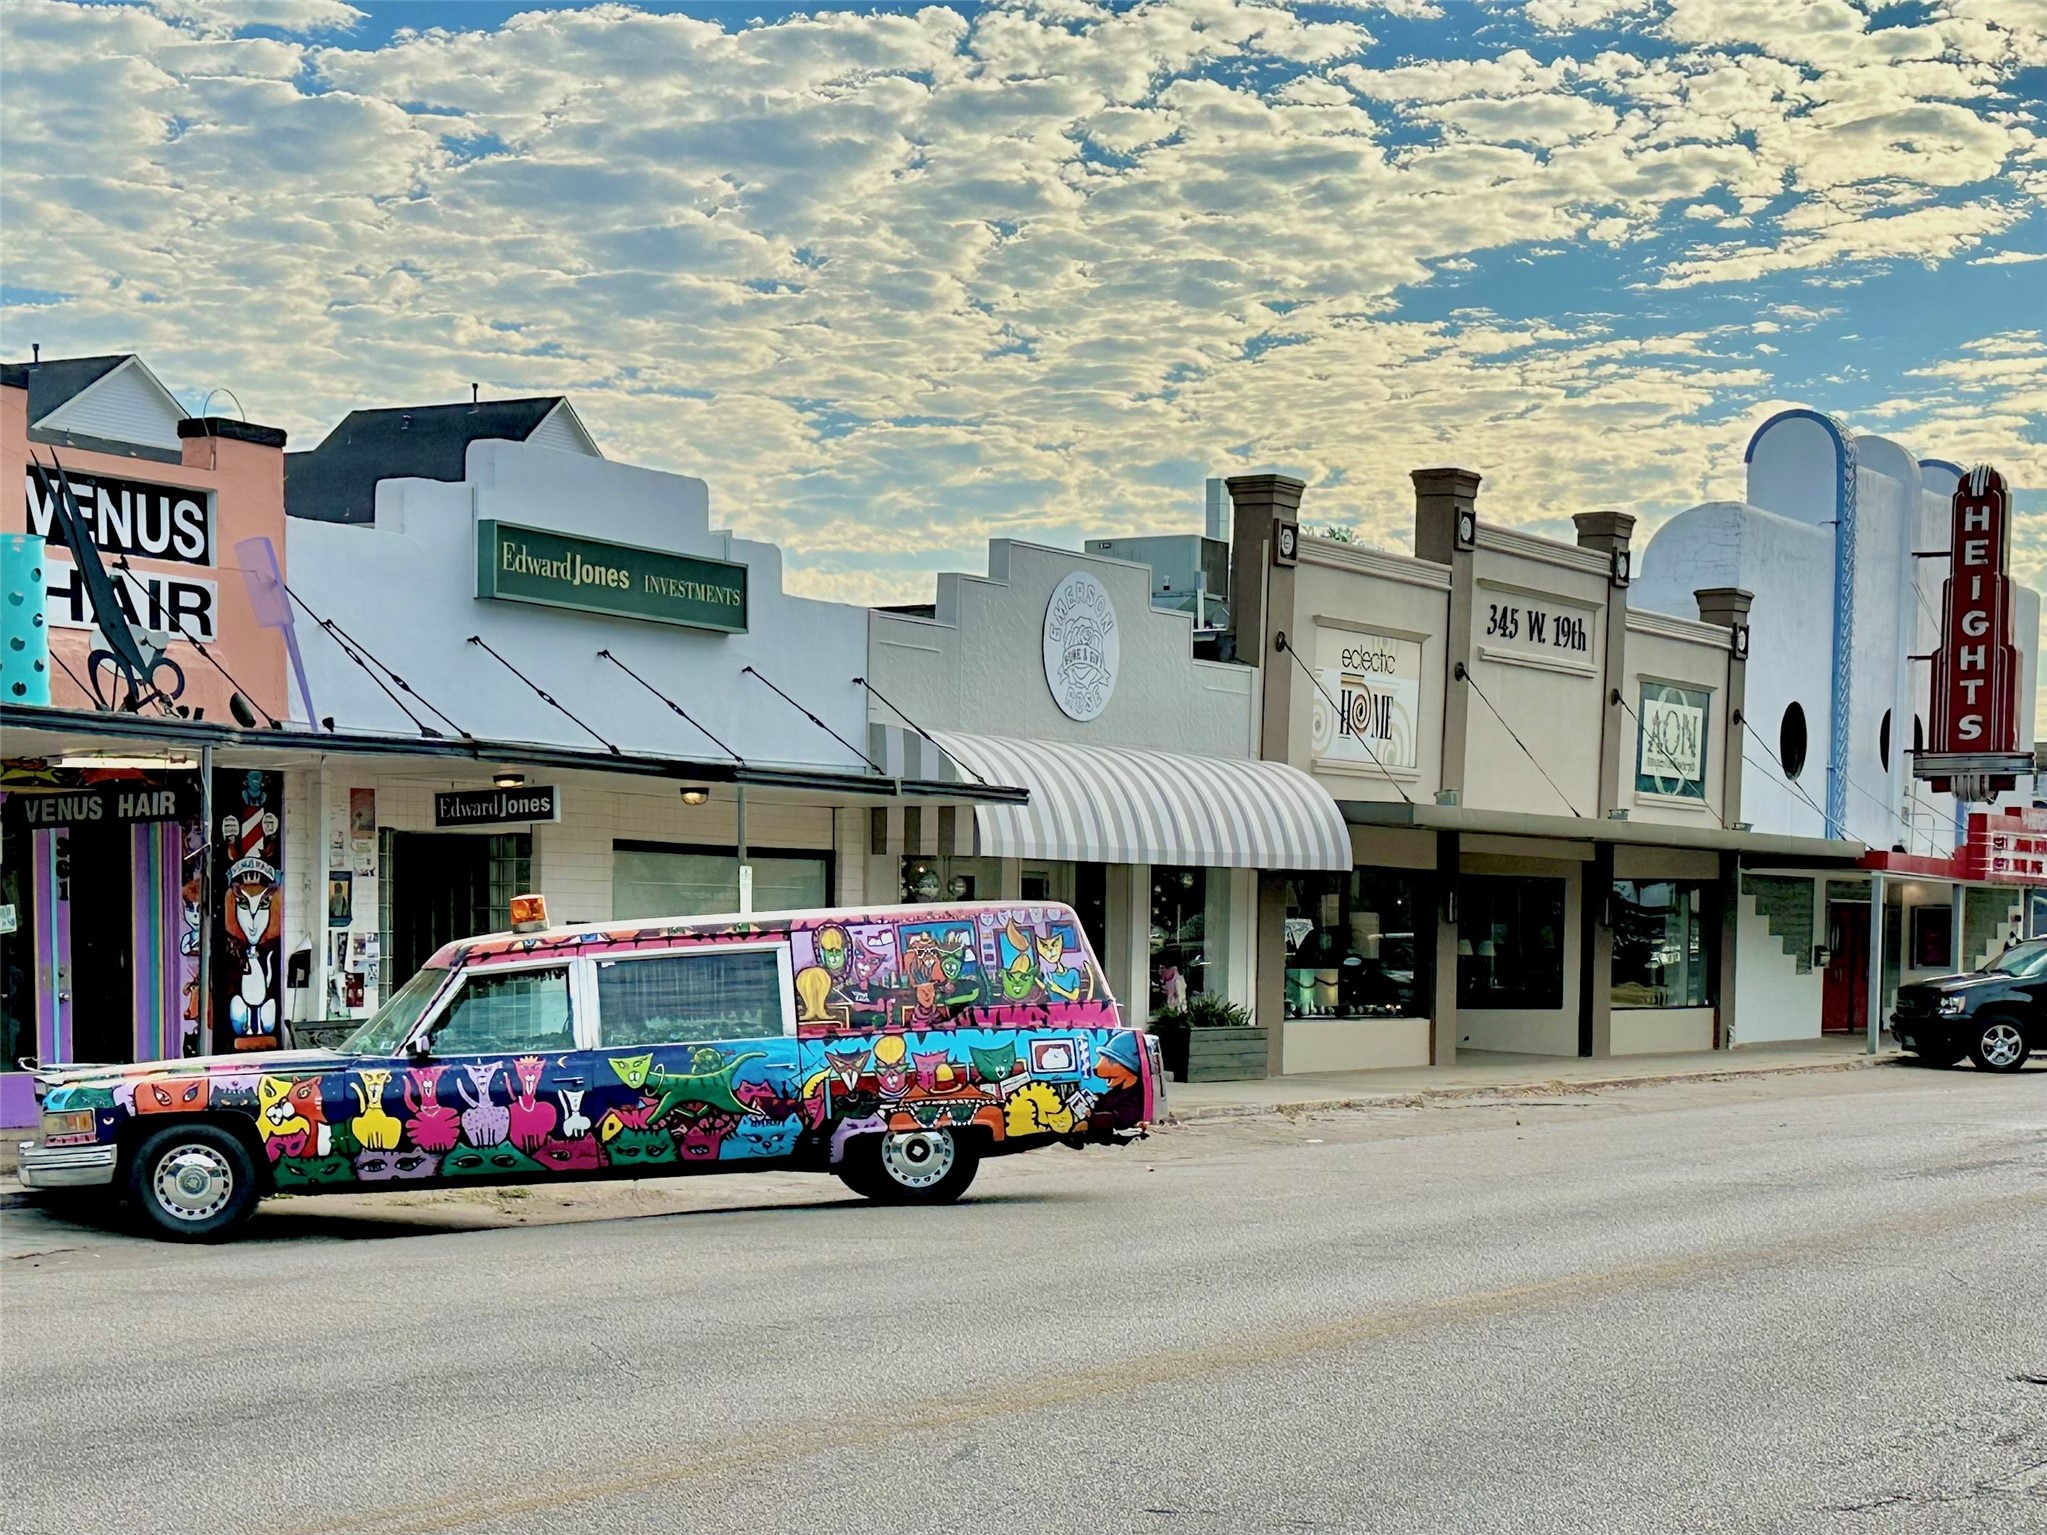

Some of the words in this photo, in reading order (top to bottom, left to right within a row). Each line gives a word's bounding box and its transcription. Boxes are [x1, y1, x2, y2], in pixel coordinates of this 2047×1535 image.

[26, 475, 206, 558] VENUS
[47, 568, 213, 637] HAIR
[644, 574, 741, 606] INVESTMENTS
[1050, 581, 1114, 642] EMERSON
[1486, 604, 1520, 639] 345
[1527, 610, 1546, 644] W.
[1553, 615, 1587, 651] 19th
[1957, 505, 1990, 741] HEIGHTS
[1341, 644, 1396, 674] eclectic
[1065, 684, 1103, 714] ROSE
[1339, 688, 1395, 740] HOME
[25, 795, 103, 823] VENUS
[118, 790, 176, 818] HAIR
